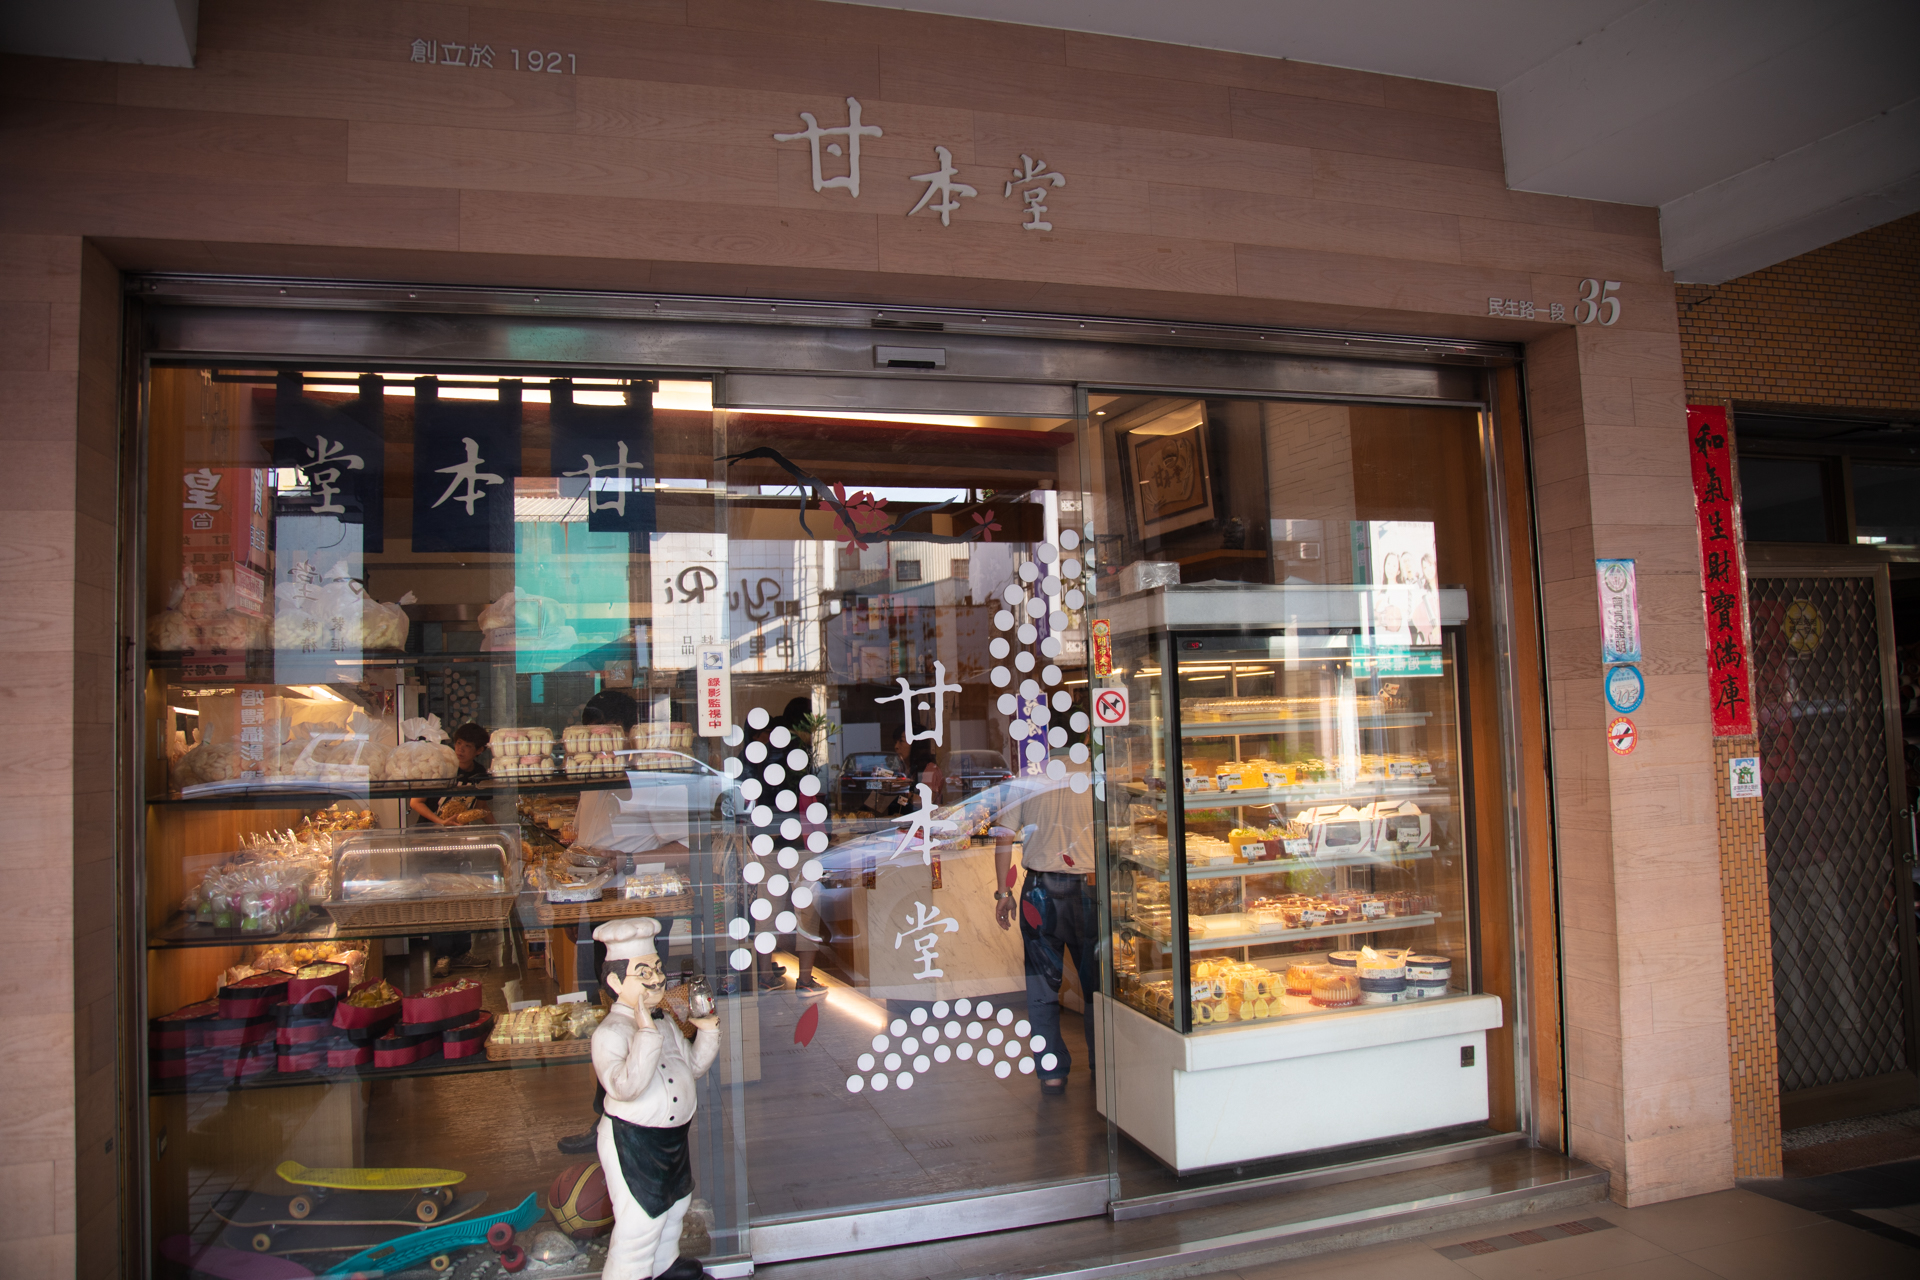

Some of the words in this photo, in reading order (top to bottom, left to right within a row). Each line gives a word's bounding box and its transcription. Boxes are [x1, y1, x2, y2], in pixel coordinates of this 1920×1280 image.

[410, 38, 496, 69] 創立於
[510, 48, 577, 75] 1921
[773, 96, 1066, 231] 甘本堂
[1488, 296, 1566, 322] 民生路一段
[1574, 278, 1621, 326] 35
[707, 677, 722, 729] 錄影監視中
[874, 660, 963, 980] 甘本堂
